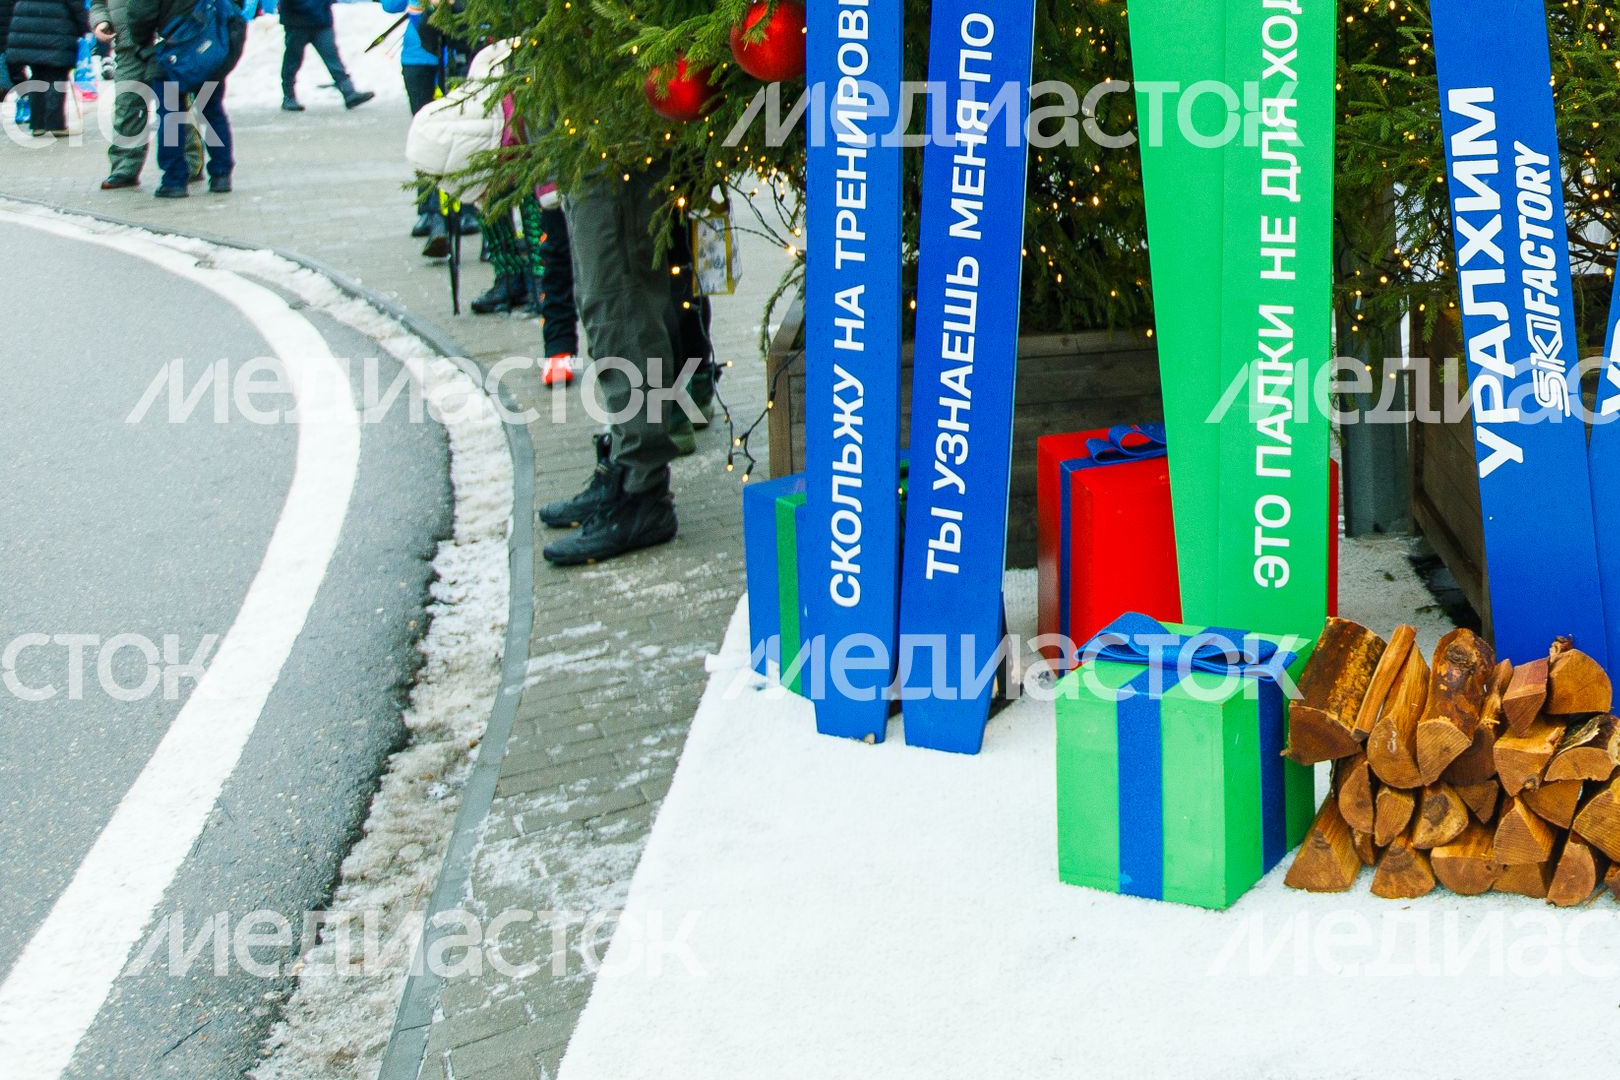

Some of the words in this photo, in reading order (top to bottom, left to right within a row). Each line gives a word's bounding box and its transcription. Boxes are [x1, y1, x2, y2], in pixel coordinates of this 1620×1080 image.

[958, 12, 995, 83] ПО
[949, 99, 990, 240] МЕНЯ
[1260, 97, 1302, 203] ДЛЯ
[1259, 214, 1298, 280] НЕ
[1447, 86, 1524, 479] УРАЛХИМ
[834, 284, 865, 352] НА
[932, 255, 980, 495] УЗНАЕШЬ
[1254, 304, 1295, 478] ПАЛКИ
[830, 363, 864, 608] СКОЛЬЖУ
[925, 506, 964, 581] ТЫ
[1253, 494, 1292, 589] ЭТО
